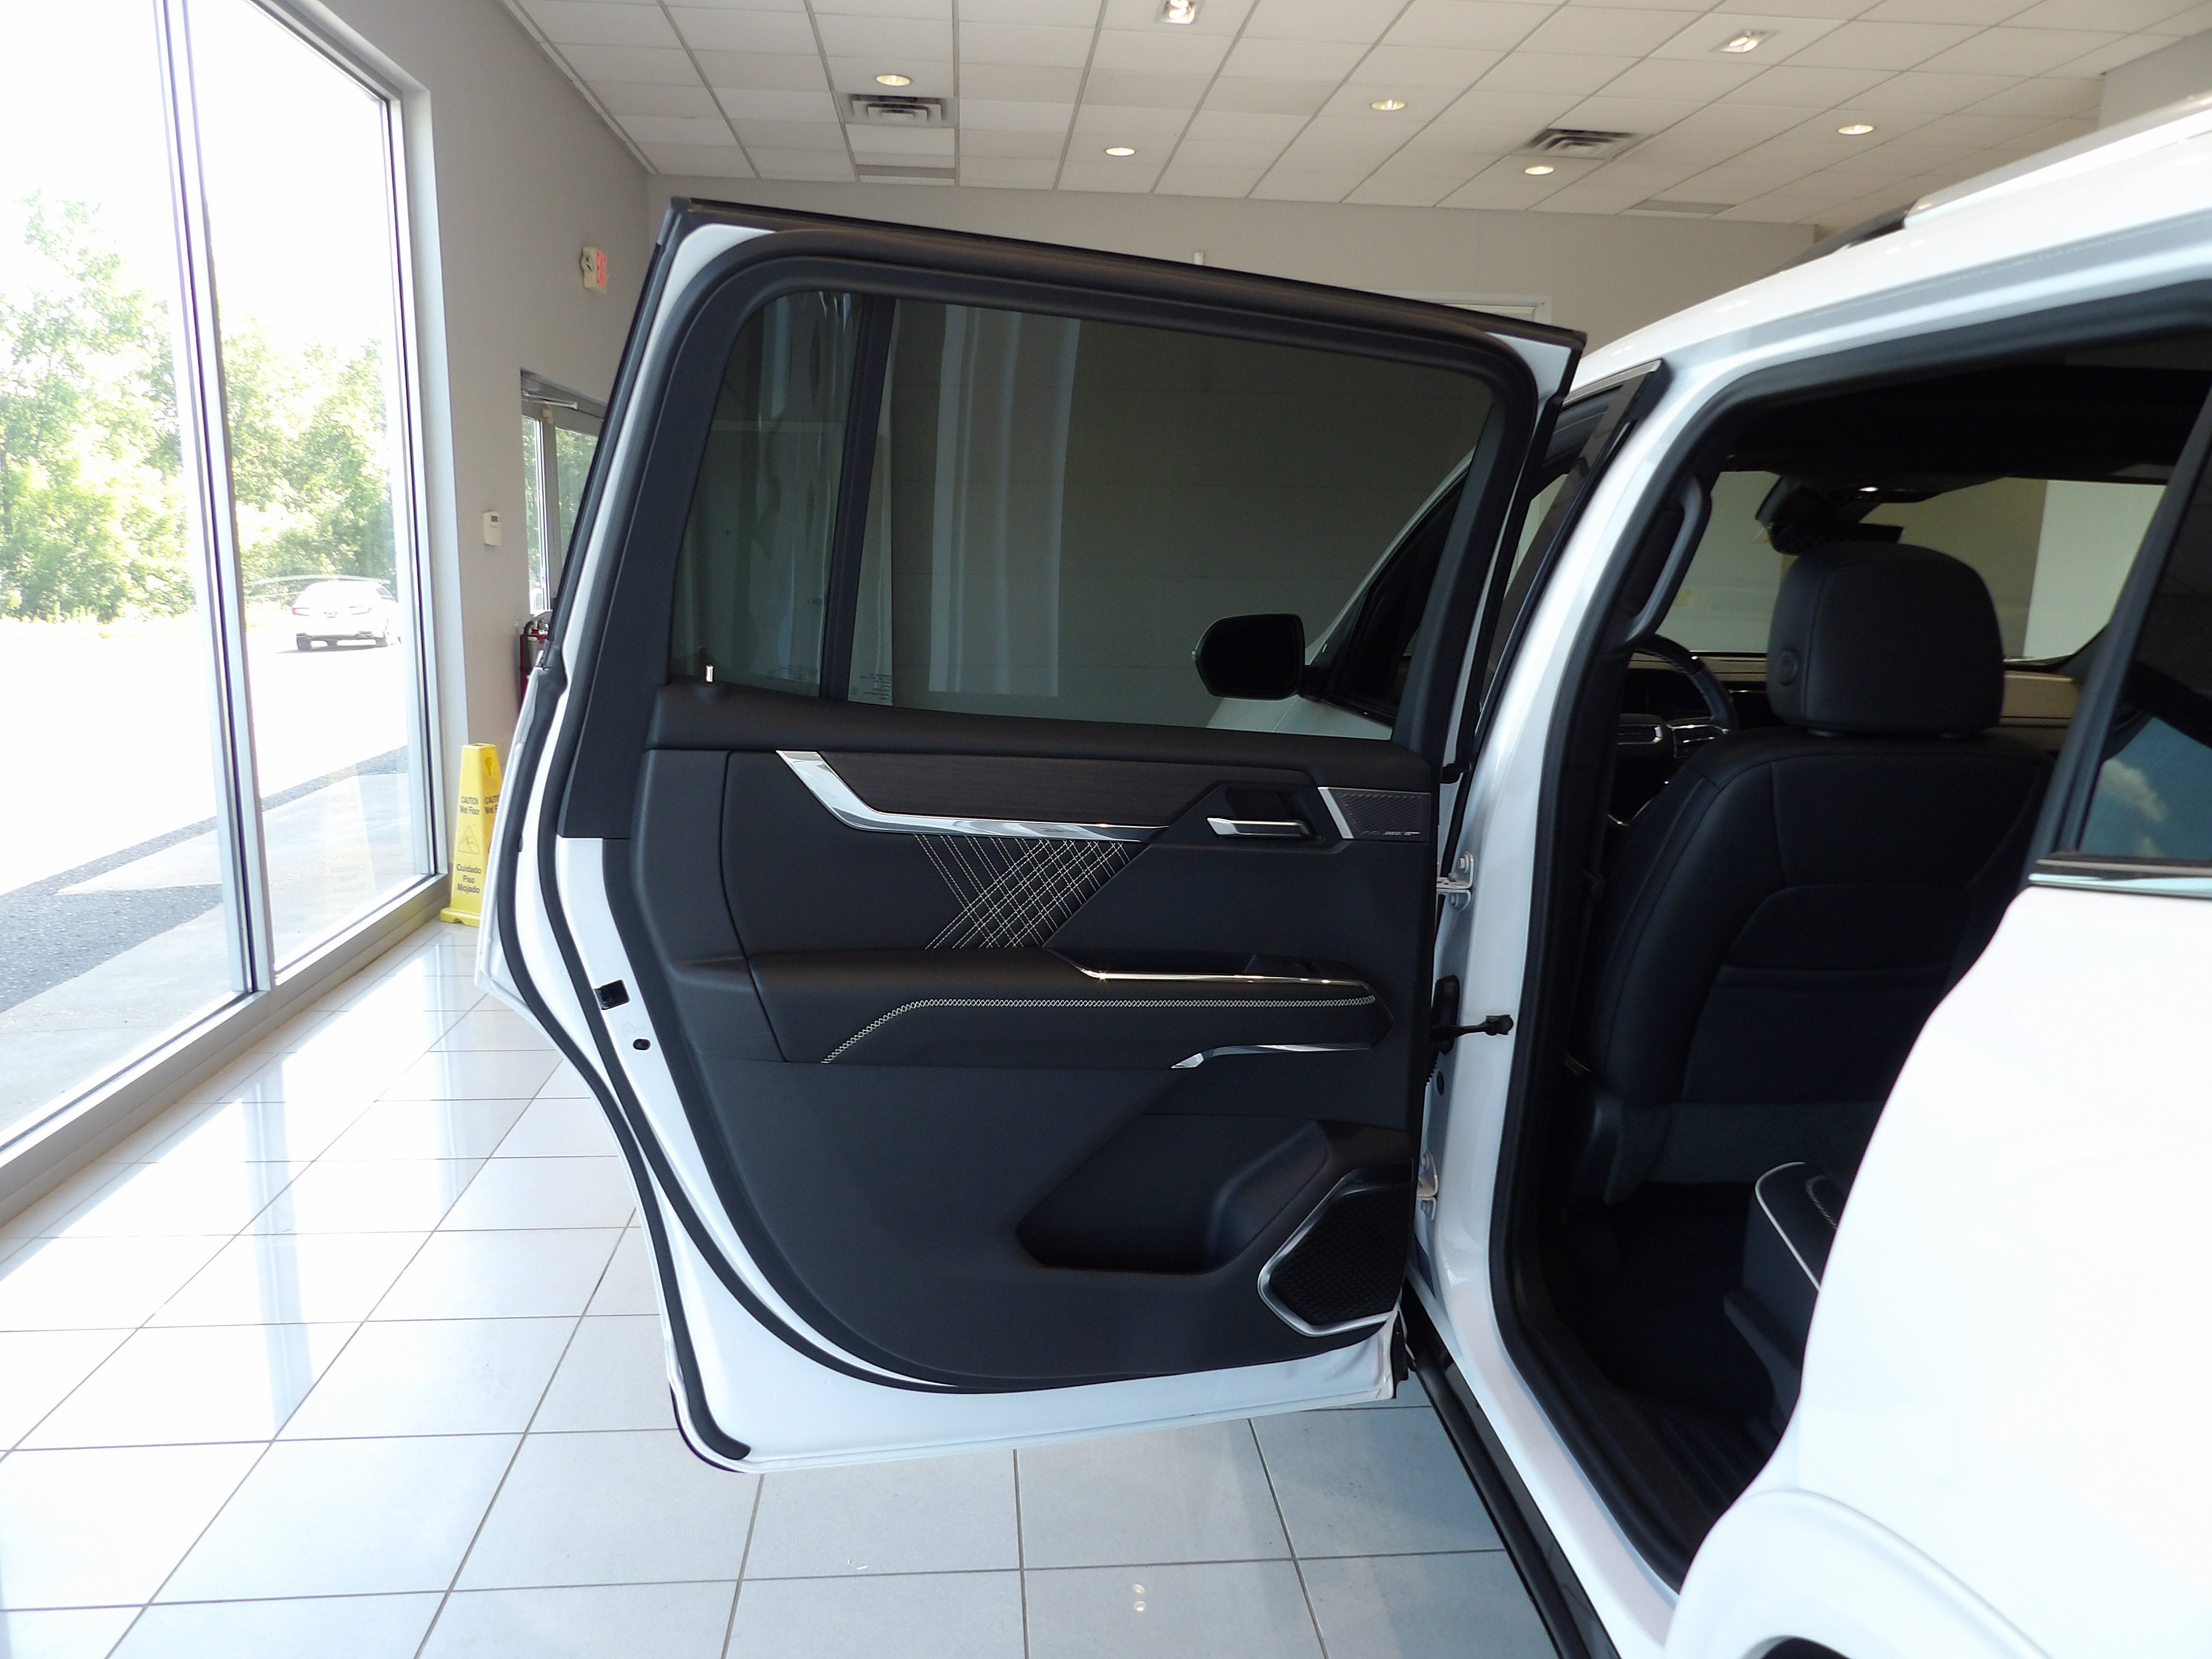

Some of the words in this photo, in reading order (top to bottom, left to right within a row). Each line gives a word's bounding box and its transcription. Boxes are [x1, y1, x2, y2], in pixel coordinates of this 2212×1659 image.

[461, 796, 479, 805] CAUTION
[485, 794, 500, 804] CAUTI
[459, 805, 468, 814] Wet
[469, 806, 481, 815] Floor
[457, 863, 481, 874] Cuidado
[463, 875, 474, 883] Piso
[457, 883, 480, 894] Mojado
